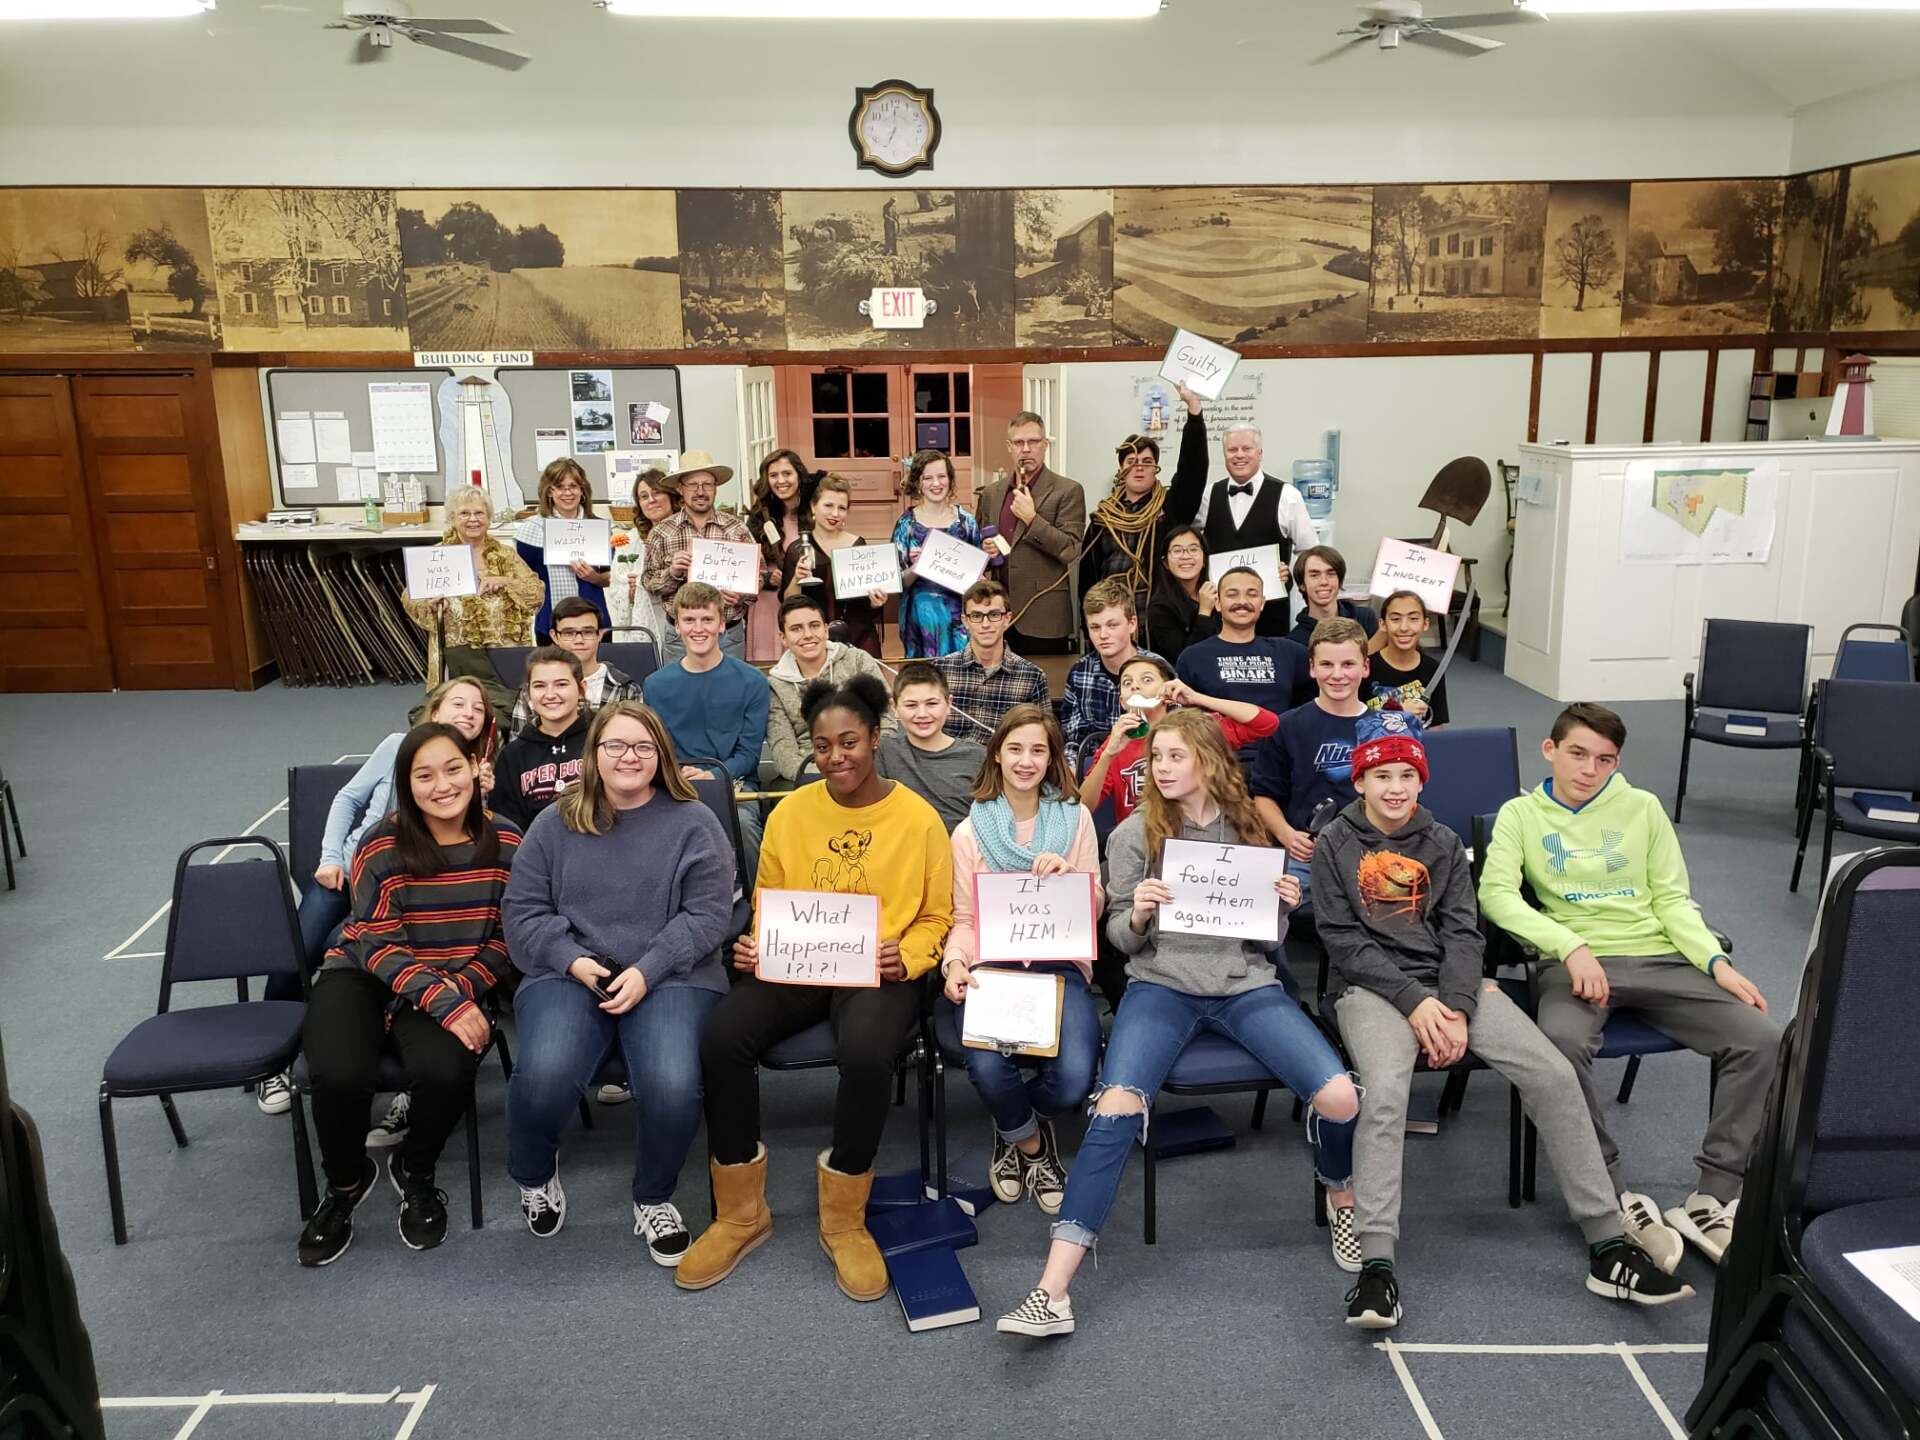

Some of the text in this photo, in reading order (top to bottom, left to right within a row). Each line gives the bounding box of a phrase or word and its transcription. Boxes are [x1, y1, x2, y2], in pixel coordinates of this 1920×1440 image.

[882, 291, 916, 317] EXIT
[421, 353, 529, 364] BUILDING FUND
[1176, 345, 1222, 382] Guilty
[566, 521, 584, 532] It
[951, 542, 963, 554] I
[430, 550, 446, 562] It
[703, 553, 747, 567] Butler
[1229, 552, 1259, 568] CALL
[427, 566, 450, 574] was
[848, 560, 878, 571] Trust
[697, 570, 739, 582] did it
[839, 569, 897, 592] ANYBODY
[1381, 562, 1446, 588] INNOCENT
[1220, 670, 1275, 679] BINARY
[1314, 743, 1353, 765] Nik
[1216, 846, 1236, 864] I
[1179, 864, 1240, 887] fooled
[1016, 879, 1047, 893] It
[1206, 891, 1255, 909] them
[1564, 889, 1636, 903] RMOUR
[791, 900, 853, 924] What
[1009, 903, 1051, 915] was
[766, 929, 865, 960] Happened
